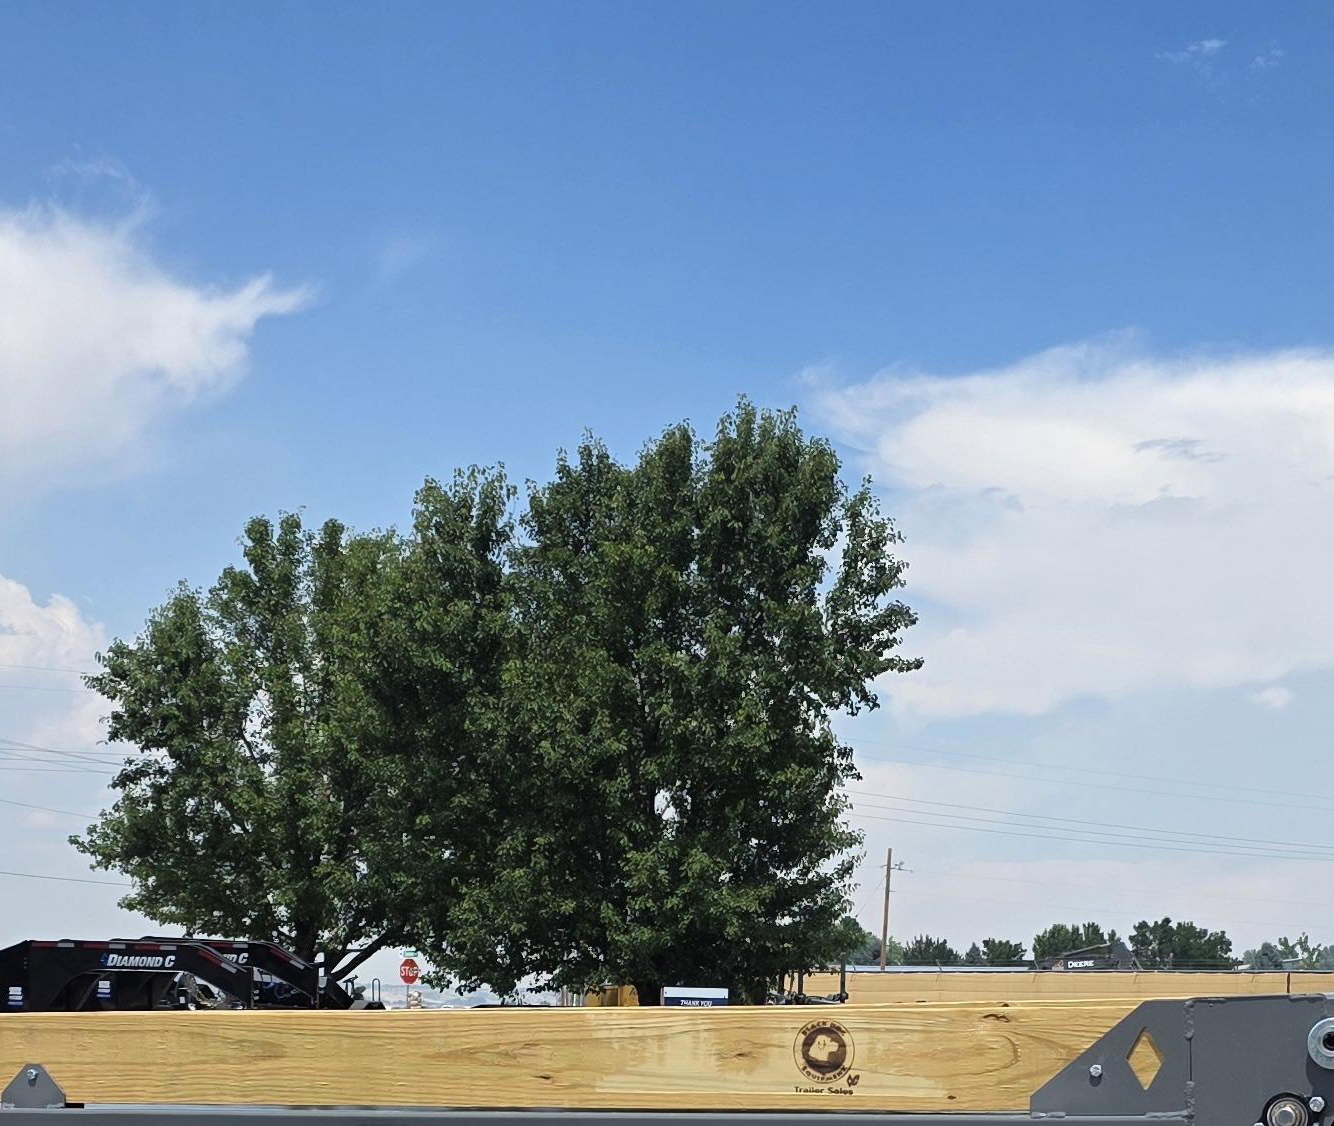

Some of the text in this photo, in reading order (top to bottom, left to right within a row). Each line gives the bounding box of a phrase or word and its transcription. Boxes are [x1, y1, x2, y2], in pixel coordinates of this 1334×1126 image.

[107, 954, 176, 967] DIAMOND C
[801, 1064, 847, 1081] EQUIPMENT
[794, 1086, 853, 1095] Trailer Sales
